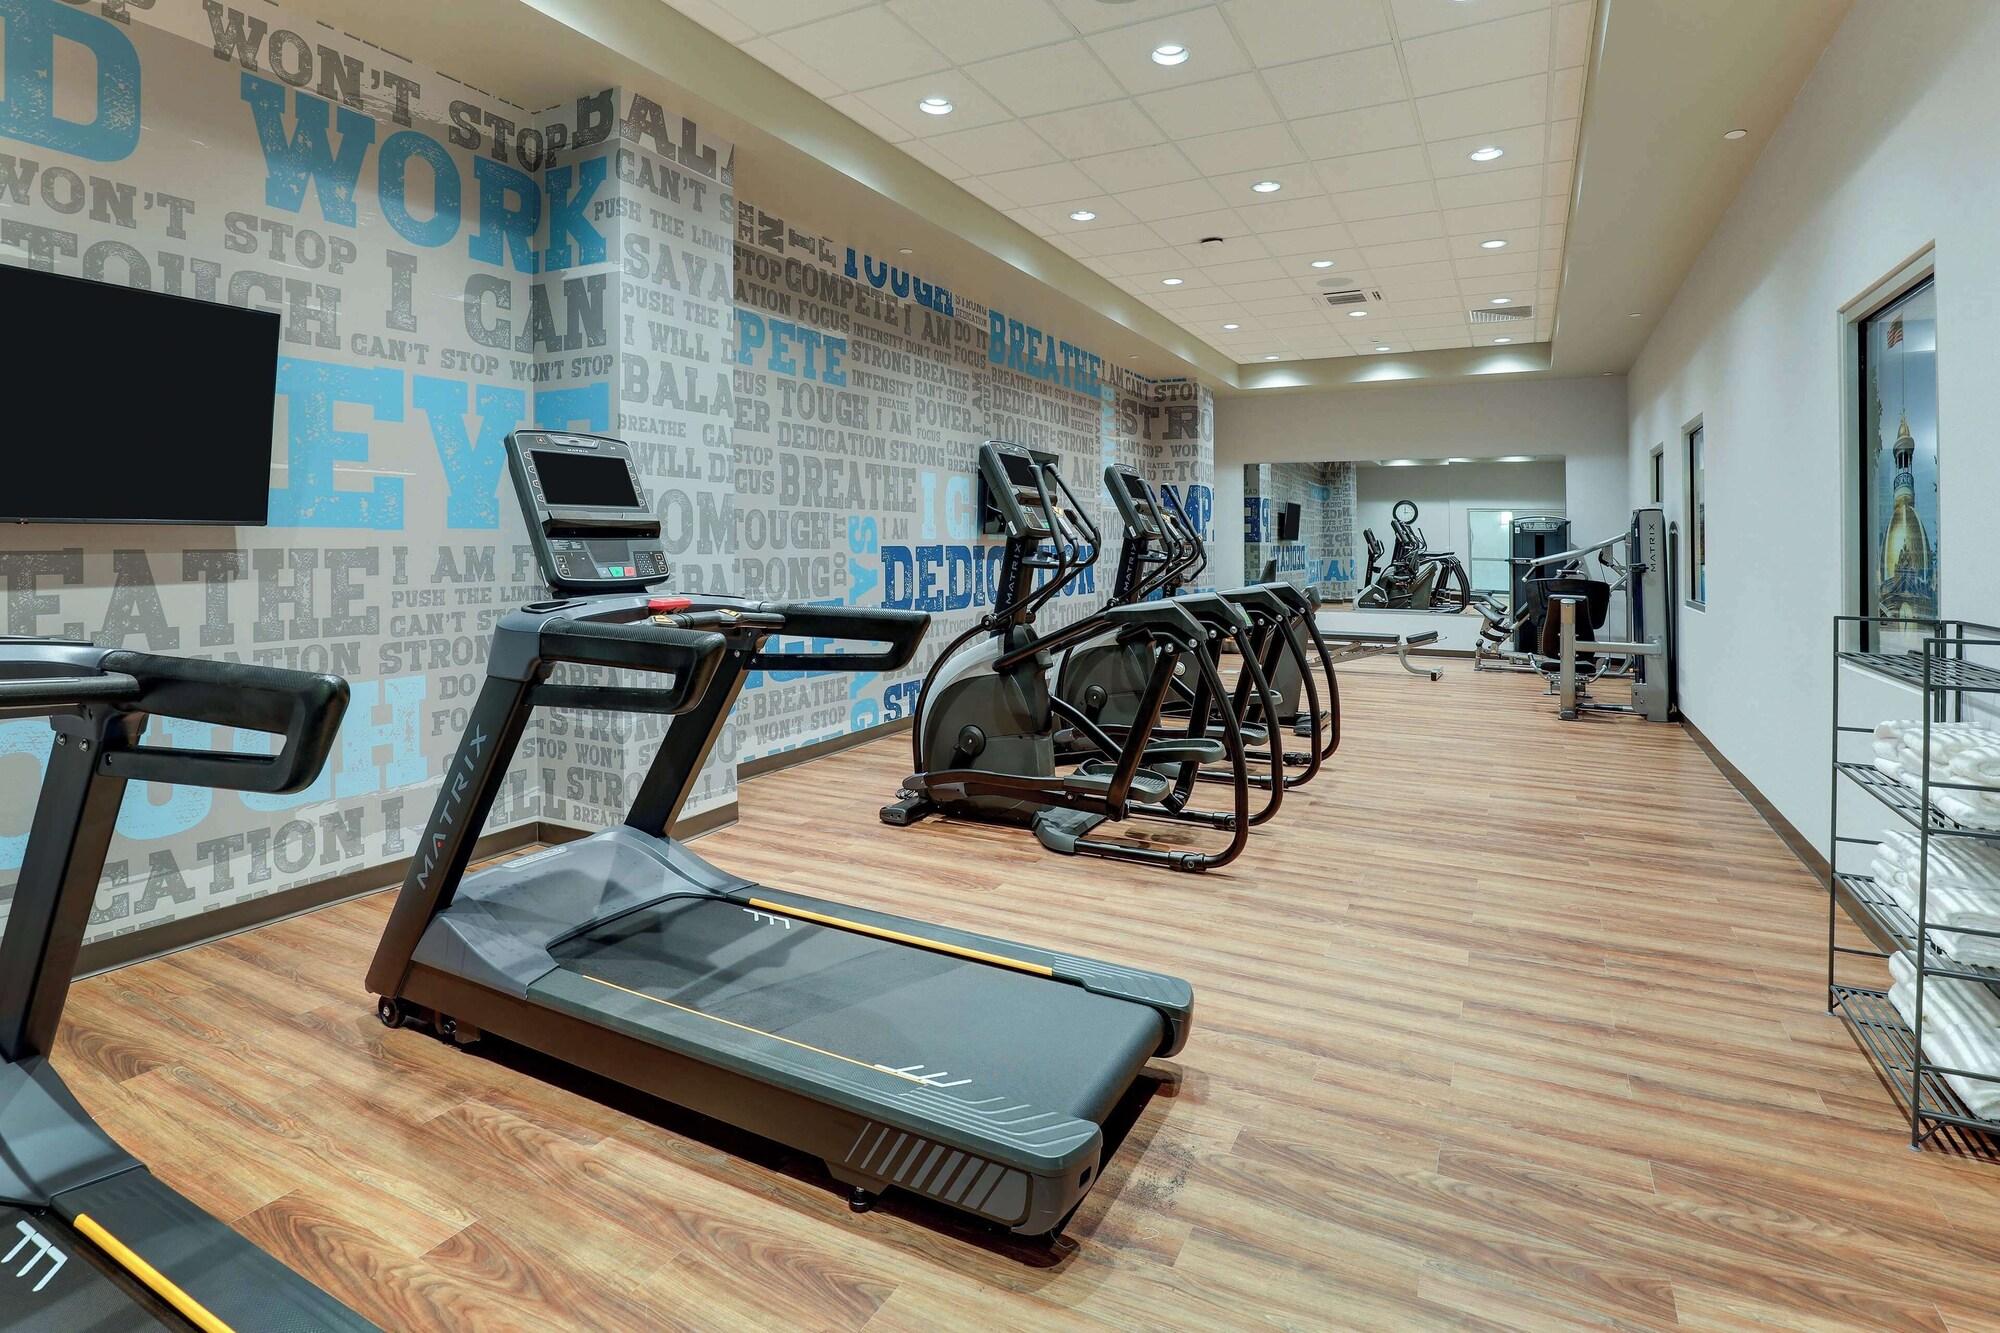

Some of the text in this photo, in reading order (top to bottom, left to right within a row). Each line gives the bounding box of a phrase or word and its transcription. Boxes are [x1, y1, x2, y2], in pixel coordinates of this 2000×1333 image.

[203, 1, 567, 172] WON'T STOP
[241, 71, 607, 274] WORK
[616, 148, 706, 212] CAN'T
[594, 197, 641, 222] PUSH
[650, 208, 684, 239] THE
[224, 211, 357, 275] STOP
[386, 249, 606, 354] I CAN
[622, 282, 674, 316] PUSH
[683, 302, 719, 328] THE
[785, 257, 898, 327] COMPETE
[798, 299, 850, 334] FOCUS
[351, 333, 429, 365] CAN'T
[441, 348, 499, 376] STOP
[571, 354, 613, 378] STOP
[648, 320, 709, 363] WILL
[988, 309, 1102, 398] BREATHE
[851, 342, 969, 392] STRONG BREATHE
[852, 369, 913, 399] INTENSITY
[618, 413, 686, 438] BREATHE
[777, 378, 869, 430] TOUGH
[915, 396, 972, 433] POWER
[992, 384, 1070, 427] DEDICATION
[777, 421, 945, 466] DEDICATION STRONG
[780, 453, 916, 513] BREATHE
[921, 471, 937, 539] I
[392, 546, 408, 585] I
[431, 545, 496, 583] AM
[1006, 543, 1022, 604] MATRIX
[392, 589, 445, 608] PUSH
[455, 587, 492, 605] THE
[390, 611, 466, 638] CAN'T
[439, 674, 476, 701] DO
[754, 676, 848, 720] BREATHE
[755, 715, 804, 745] WON'T
[810, 706, 846, 730] STOP
[522, 737, 567, 760] STOP
[575, 743, 628, 770] WON'T
[382, 797, 404, 857] I
[417, 724, 488, 890] MATRIX
